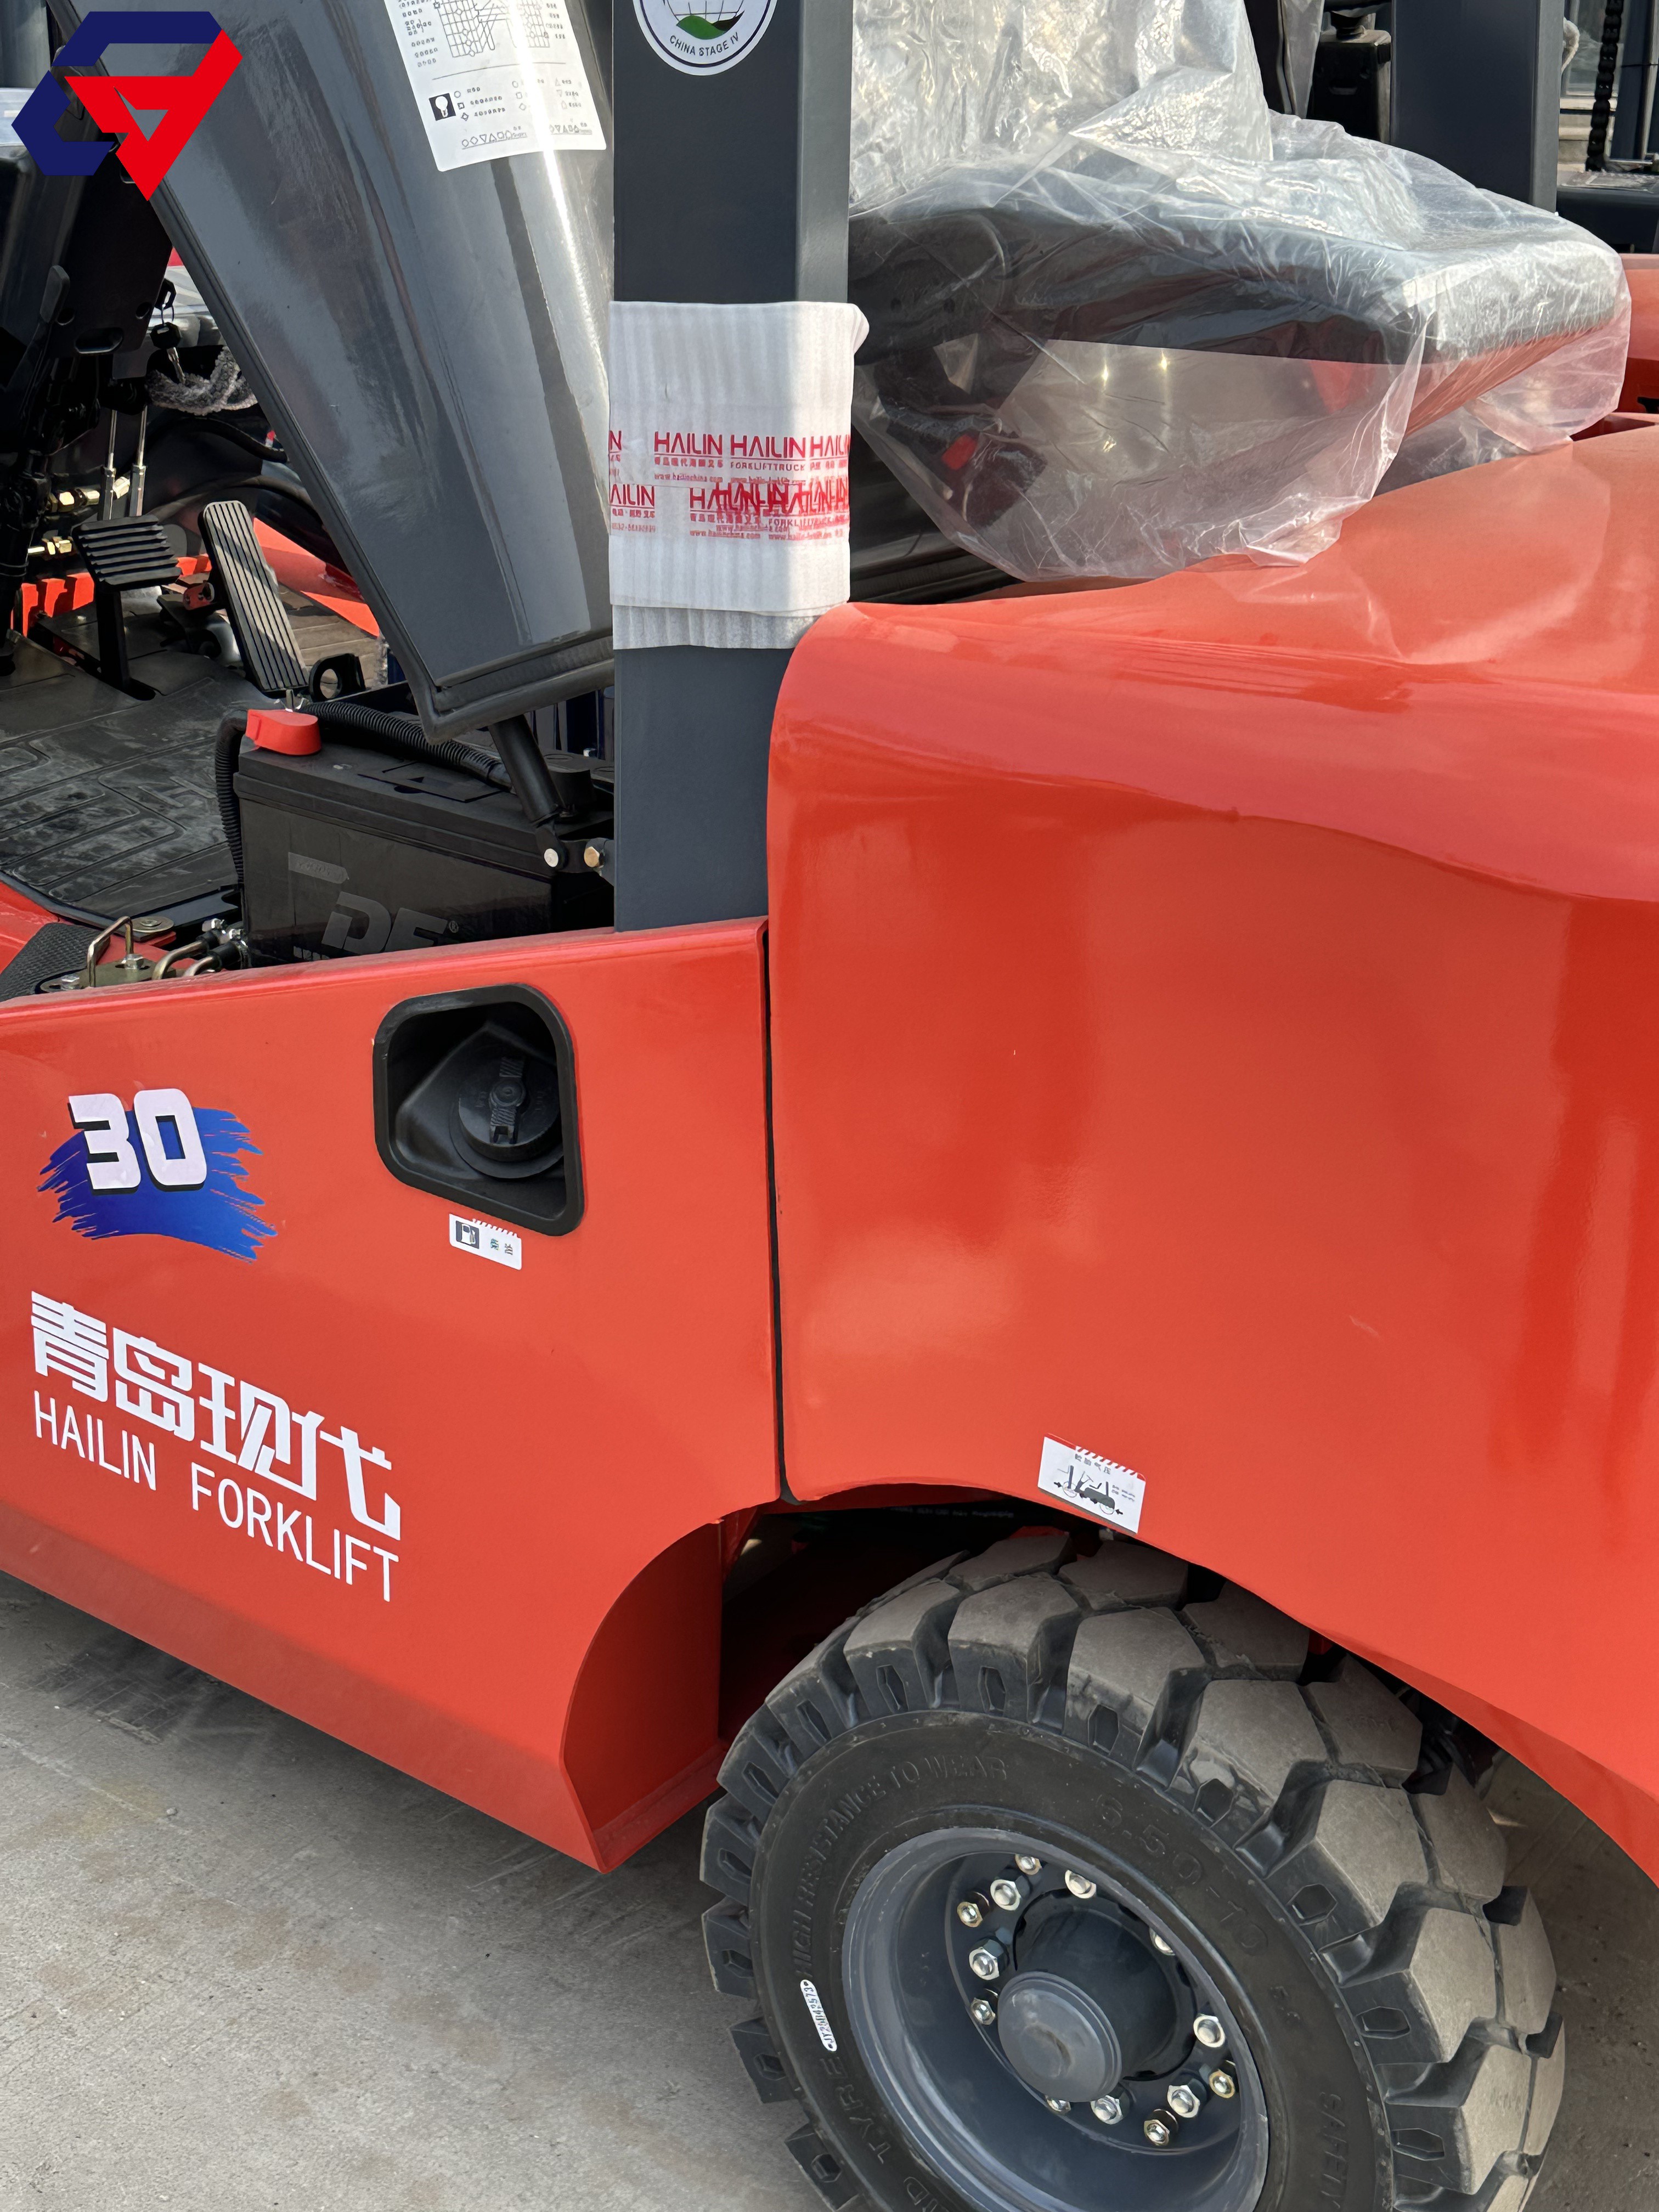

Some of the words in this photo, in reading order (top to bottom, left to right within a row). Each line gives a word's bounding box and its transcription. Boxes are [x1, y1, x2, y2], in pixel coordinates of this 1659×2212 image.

[669, 35, 696, 56] CHINA
[698, 40, 729, 57] STAGE
[730, 31, 739, 44] IV
[654, 431, 723, 455] HAILIN
[730, 434, 806, 458] HAILIN
[69, 1088, 208, 1195] 30
[31, 1290, 401, 1541] 青岛现代
[33, 1390, 156, 1491] HAILIN
[191, 1462, 399, 1602] FORKLIFT
[818, 2056, 892, 2165] TYRE
